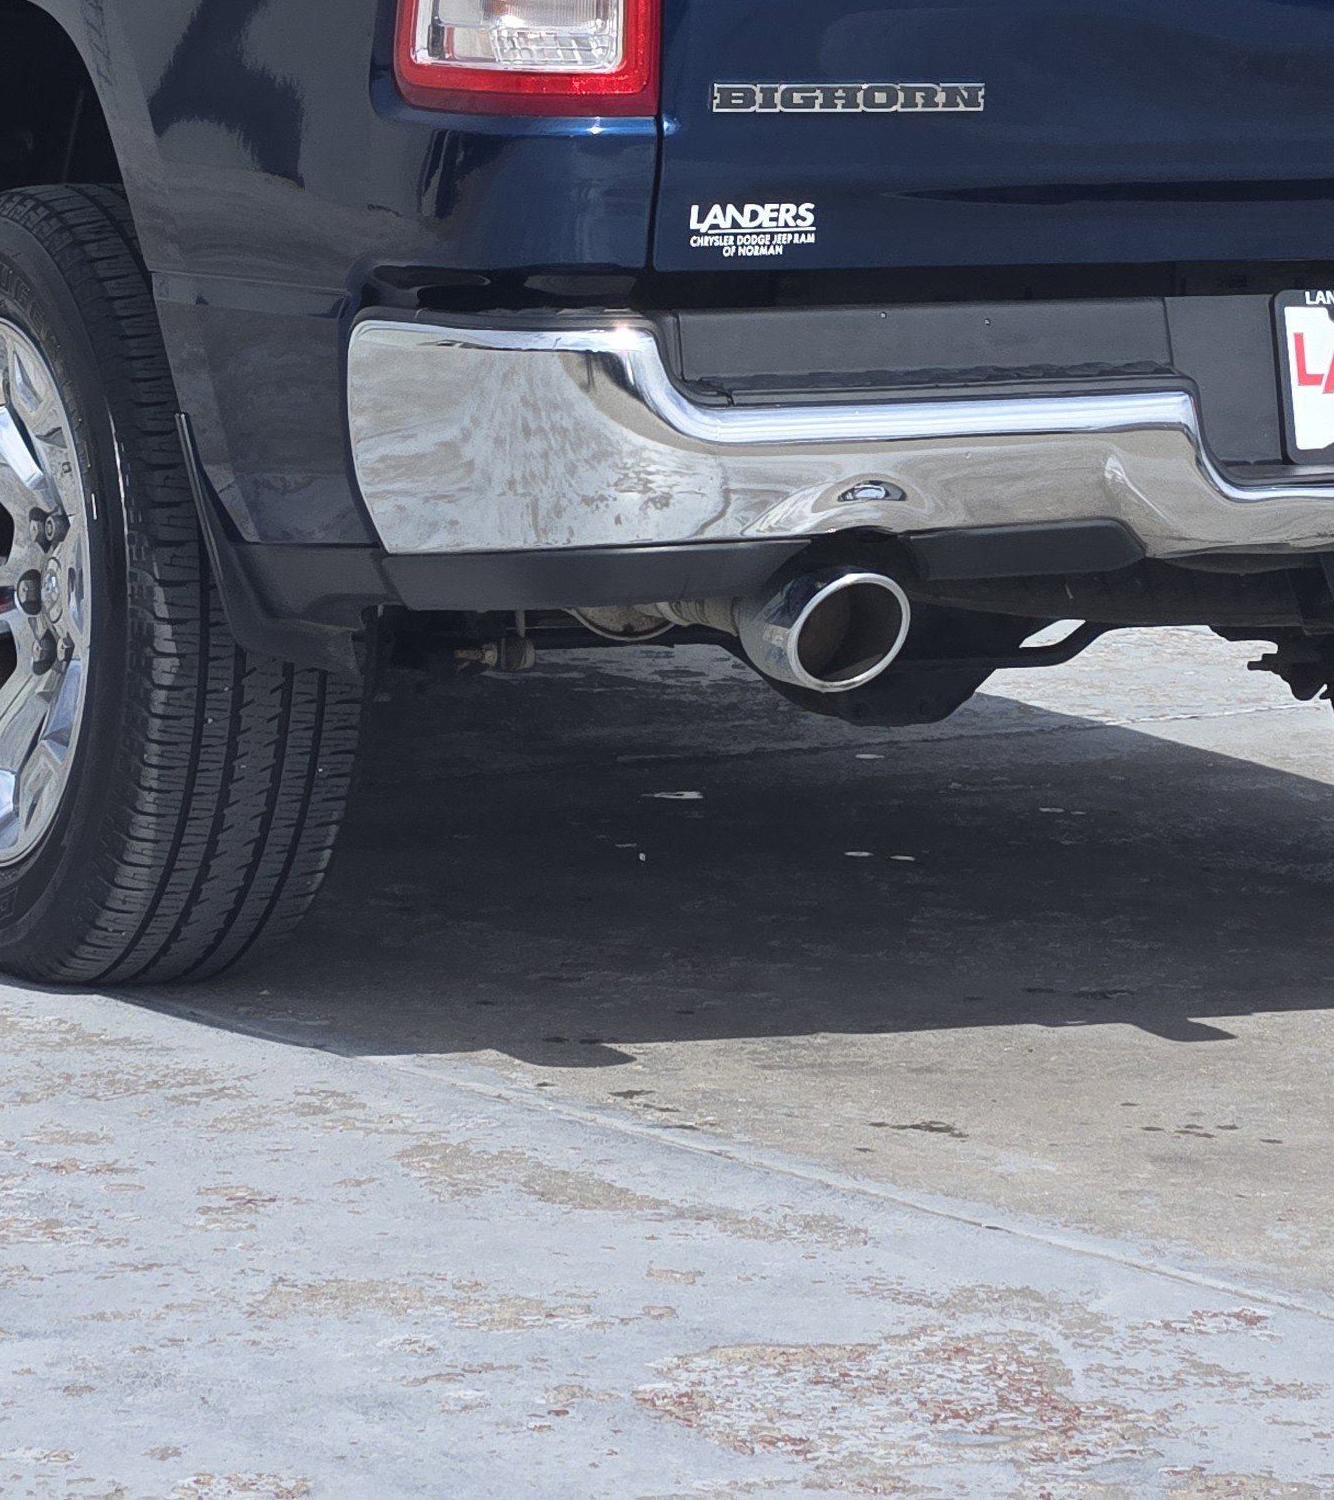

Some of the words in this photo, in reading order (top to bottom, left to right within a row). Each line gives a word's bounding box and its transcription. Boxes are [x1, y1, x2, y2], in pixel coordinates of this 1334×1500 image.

[713, 82, 985, 113] BIGHORN
[689, 202, 816, 234] LANDERS
[689, 235, 735, 247] CHRYSLER
[736, 233, 771, 246] DODGE
[772, 233, 793, 245] JEEP
[793, 232, 815, 244] RAM
[722, 245, 736, 257] OF
[737, 244, 783, 257] NORMAN
